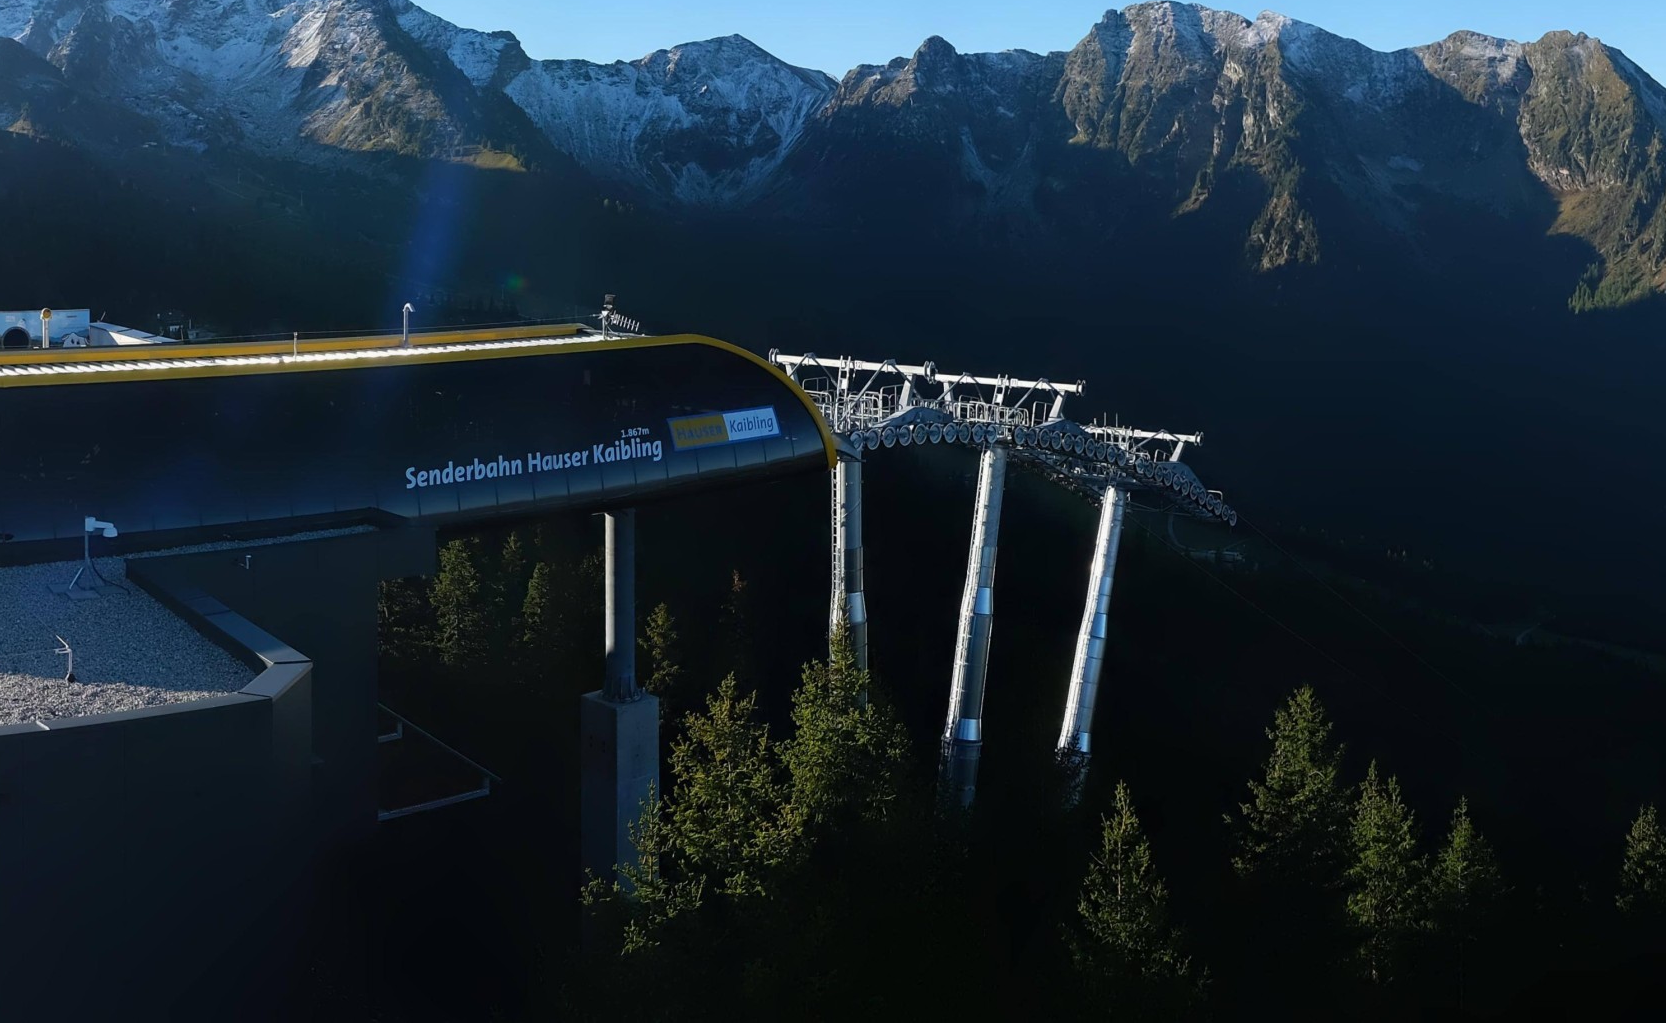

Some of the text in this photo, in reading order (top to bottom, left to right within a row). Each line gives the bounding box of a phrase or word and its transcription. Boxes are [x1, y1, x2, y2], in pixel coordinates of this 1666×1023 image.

[621, 427, 650, 439] 1.867m
[730, 416, 775, 433] Kaibling
[405, 437, 663, 489] Senderbahn Hauser Kaibling
